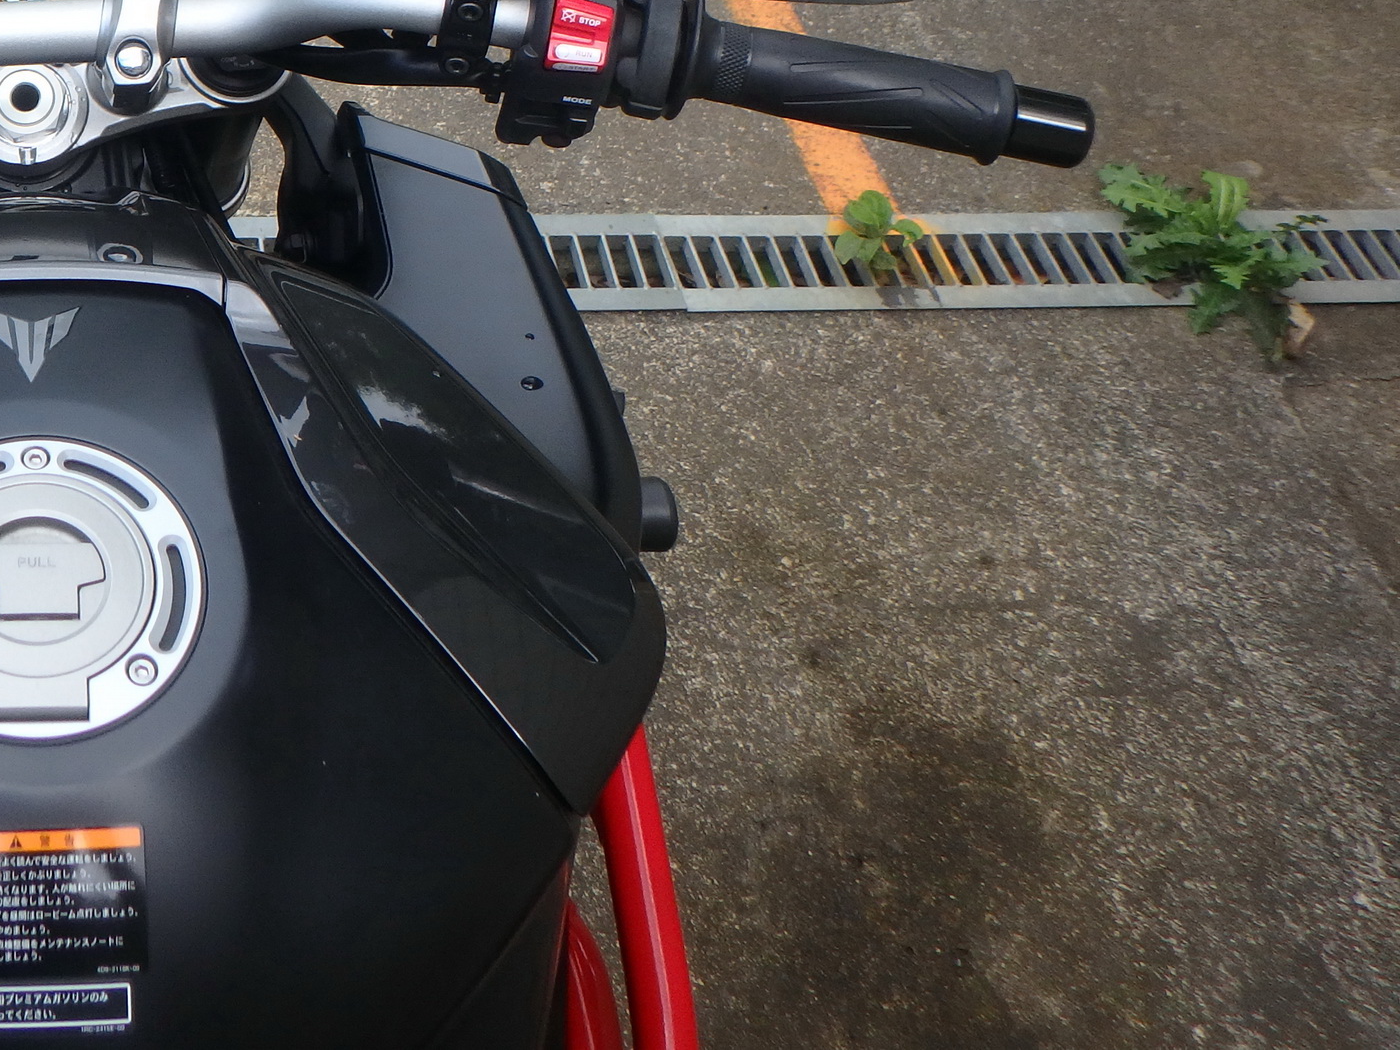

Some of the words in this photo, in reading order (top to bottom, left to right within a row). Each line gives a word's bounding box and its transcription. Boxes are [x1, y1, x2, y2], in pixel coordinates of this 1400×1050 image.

[579, 17, 601, 27] STOP
[575, 50, 593, 58] RUN
[562, 95, 592, 106] MODE
[17, 556, 56, 568] PULL
